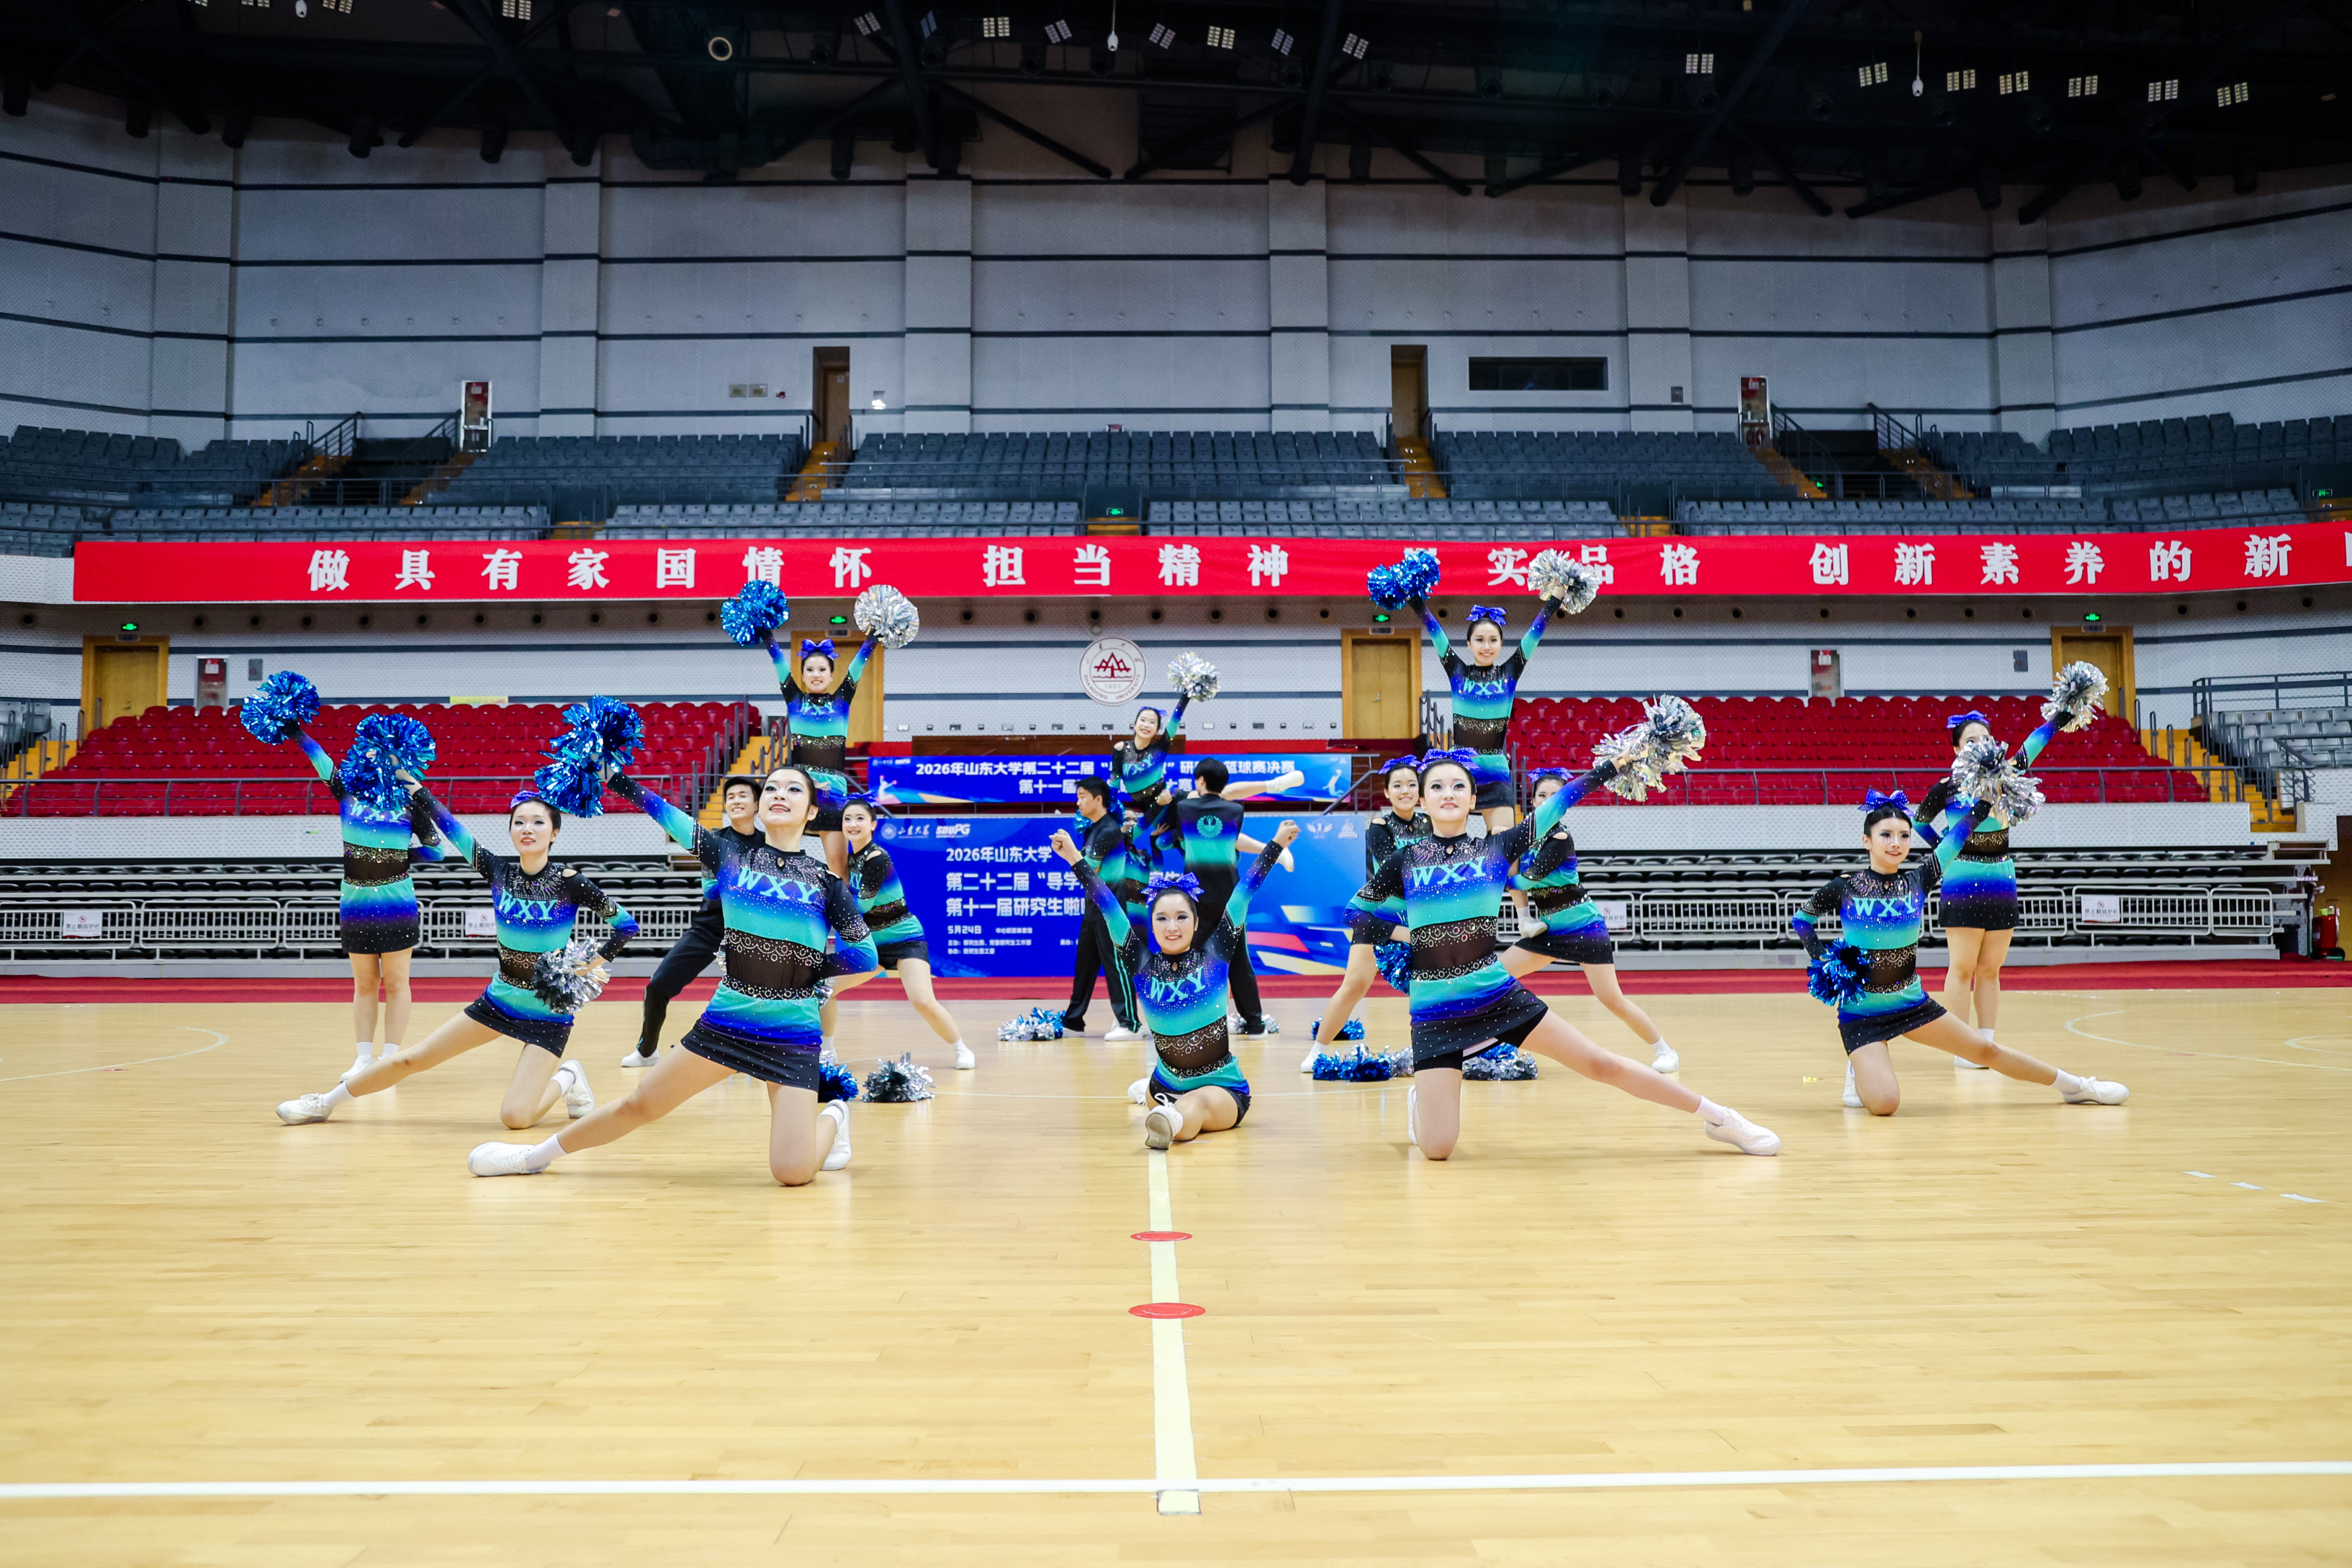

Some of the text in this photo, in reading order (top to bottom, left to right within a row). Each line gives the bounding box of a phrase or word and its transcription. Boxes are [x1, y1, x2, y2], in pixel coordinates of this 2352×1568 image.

[308, 532, 2352, 591] 做具有家国情怀 担当精神 实品格 创新素养的新
[1115, 674, 1141, 700] UNIVERSITY
[946, 846, 1052, 862] 2026年山东大学
[737, 867, 821, 904] WXY
[1411, 856, 1487, 888] WXY
[499, 888, 559, 920] WXY
[1852, 891, 1916, 917] WXY
[948, 925, 981, 934] 5月24日
[1150, 965, 1205, 1002] WXY
